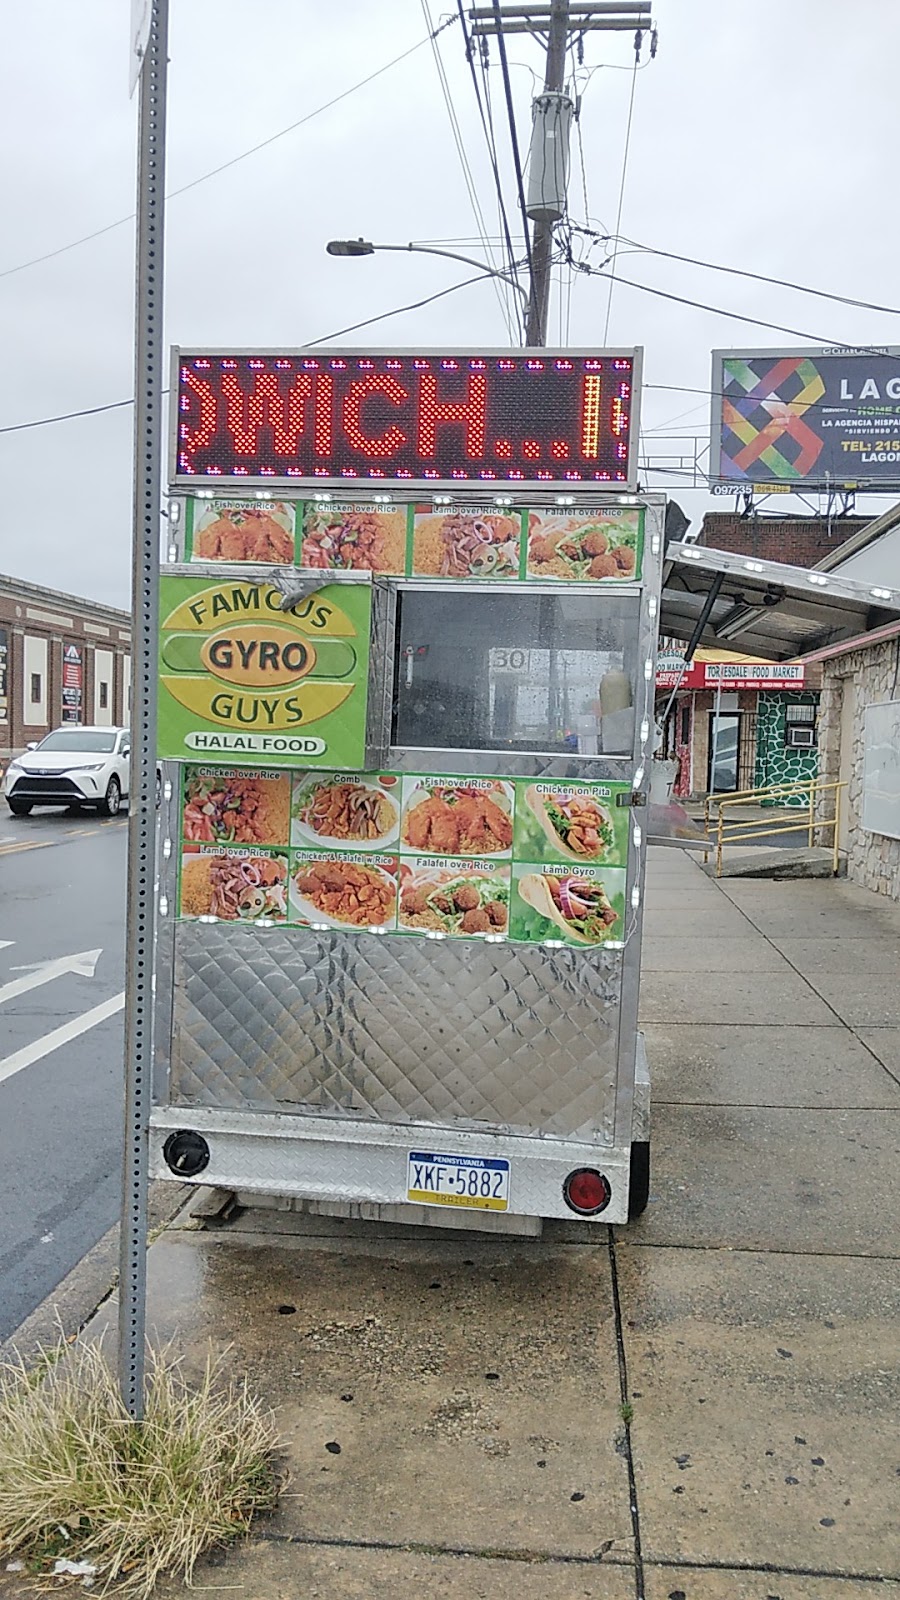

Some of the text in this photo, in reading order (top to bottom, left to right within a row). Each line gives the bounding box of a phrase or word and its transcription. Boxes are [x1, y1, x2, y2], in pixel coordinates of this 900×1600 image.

[858, 406, 892, 416] HOME
[821, 419, 833, 427] LA
[834, 419, 873, 427] AGENCIA
[841, 440, 871, 451] TEL:
[714, 485, 753, 495] 097235
[214, 501, 275, 511] Fish over Rice
[317, 503, 353, 512] Chicken
[377, 505, 397, 513] Rice
[432, 505, 502, 515] Lamb over Rice
[602, 509, 622, 517] Rice
[209, 639, 308, 671] GYRO
[493, 649, 525, 670] 30
[708, 665, 799, 678] TORESDALE FOOD MARKET
[210, 693, 304, 724] GUYS
[194, 734, 317, 752] HALAL FOOD
[199, 767, 280, 781] Chicken over Rice
[334, 774, 360, 785] Comb
[425, 777, 492, 789] Fish over Rice
[536, 784, 610, 797] Chicken on Pita
[201, 845, 269, 858] Lamb over Rice
[296, 851, 328, 860] Chicken
[339, 853, 364, 862] Falafel
[416, 858, 494, 871] Falafel over Rice
[543, 865, 595, 878] Lamb Gyro
[433, 1155, 485, 1167] PENNSYLVANIA
[435, 1194, 479, 1206] TRAILER
